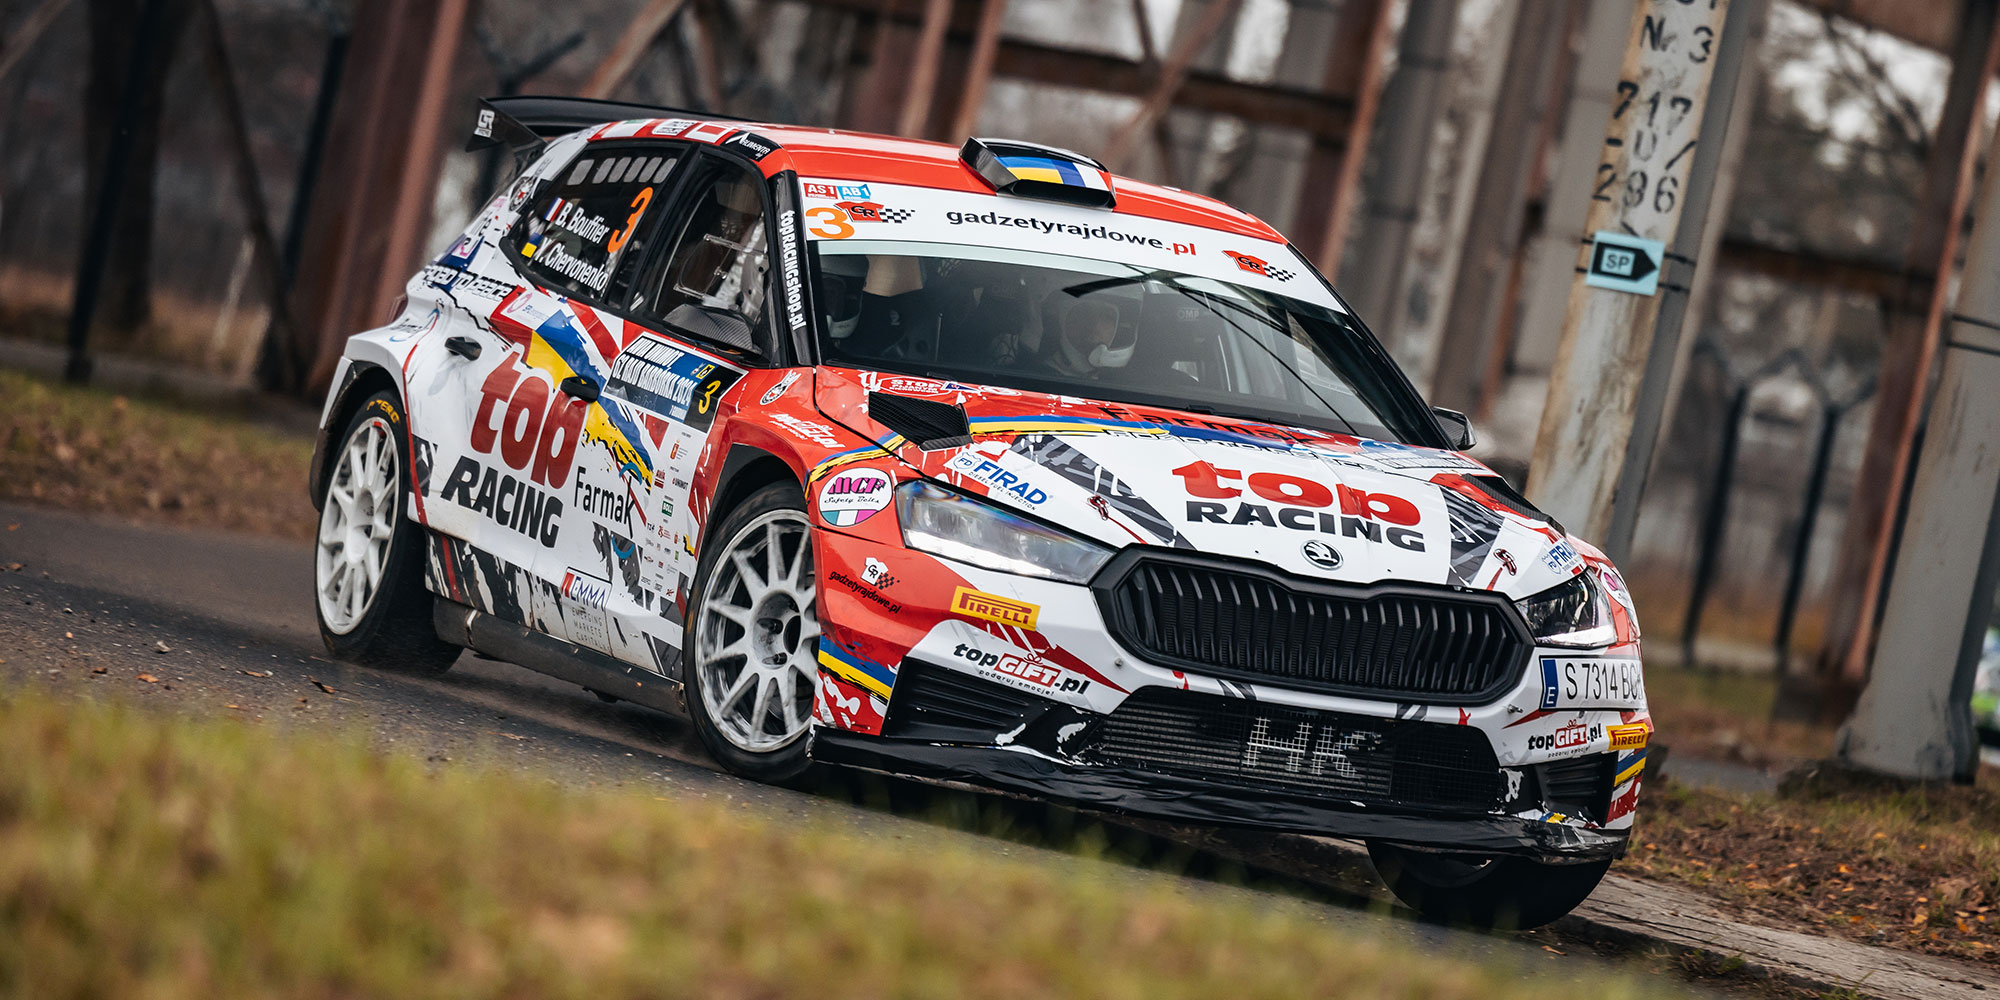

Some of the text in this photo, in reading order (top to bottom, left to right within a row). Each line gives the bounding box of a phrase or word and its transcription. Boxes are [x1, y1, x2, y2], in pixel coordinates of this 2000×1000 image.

[1689, 26, 1713, 63] 3
[1614, 81, 1692, 136] 717
[555, 202, 610, 244] B. Bouffier
[608, 187, 654, 253] 3
[805, 207, 855, 239] 3
[946, 211, 1197, 256] gadzetyrajdowe.pl
[544, 242, 609, 291] Chervonenko
[779, 210, 807, 331] topRACINGshop.pl
[1605, 254, 1630, 272] SP
[643, 342, 685, 368] UNIMOT
[672, 376, 698, 407] 2024
[698, 380, 721, 414] 3
[890, 379, 941, 388] STOP
[470, 351, 590, 489] top
[1097, 407, 1319, 446] Farmak
[958, 458, 1047, 504] FD FIRAD
[1171, 460, 1421, 526] top
[441, 456, 563, 548] RACING
[574, 466, 635, 539] Farmak
[1187, 500, 1426, 552] RACING
[868, 564, 879, 578] GR
[1548, 541, 1577, 566] FIRA
[571, 576, 606, 612] EMMA
[828, 571, 902, 614] gadzetyrajdowe.pl
[959, 592, 1033, 624] PIRELLI
[953, 643, 1091, 695] topGIFT.pl
[979, 670, 1055, 697] podaruj emocje!
[1565, 663, 1578, 700] S
[1581, 663, 1618, 700] 7314
[1547, 687, 1556, 704] E
[1528, 723, 1602, 750] topGIFT.pl
[1611, 728, 1646, 746] PIRELLI
